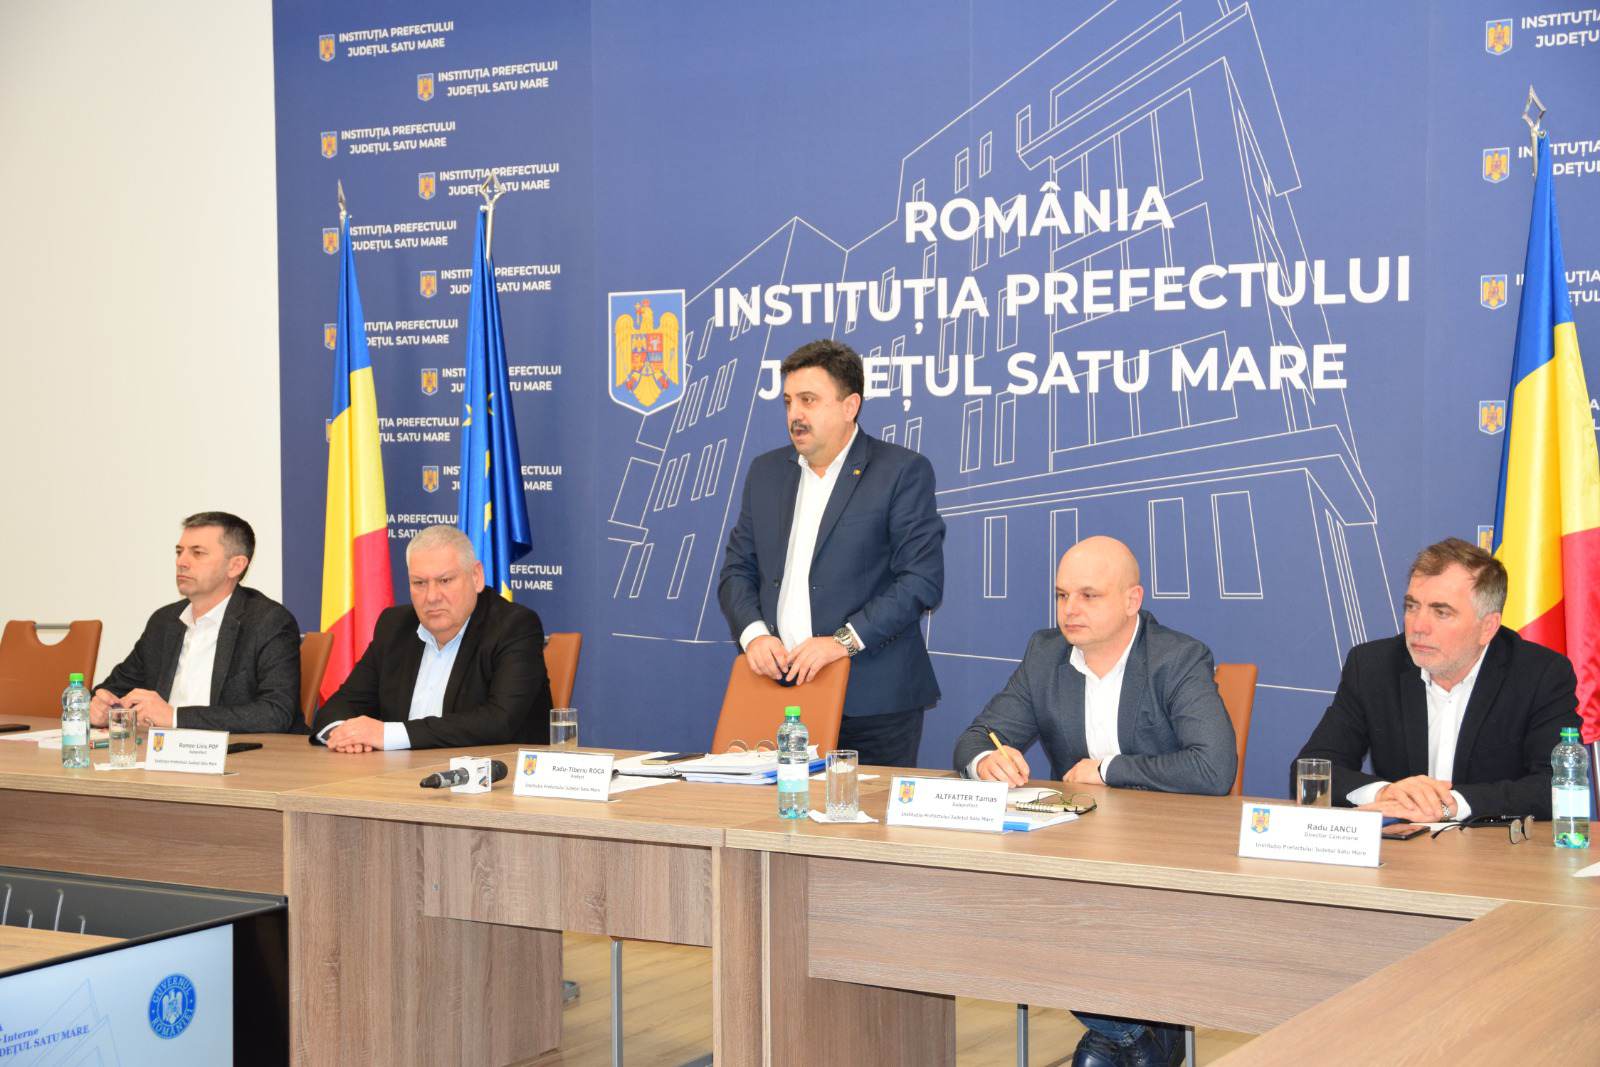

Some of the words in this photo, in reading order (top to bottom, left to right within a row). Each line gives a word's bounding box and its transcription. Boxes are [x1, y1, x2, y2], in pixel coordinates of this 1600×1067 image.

[1522, 9, 1600, 29] INSTITUȚI
[339, 29, 389, 42] INSTITUȚIA
[390, 21, 454, 37] PREFECTULUI
[1535, 30, 1600, 48] JUDEȚU
[348, 44, 389, 56] JUDEȚUL
[391, 41, 415, 52] SATU
[418, 38, 445, 49] MARE
[438, 68, 490, 82] INSTITUȚIA
[492, 61, 558, 76] PREFECTULUI
[448, 84, 490, 96] JUDEȚUL
[492, 80, 517, 92] SATU
[520, 78, 549, 89] MARE
[341, 127, 390, 140] INSTITUȚIA
[392, 121, 456, 135] PREFECTULUI
[350, 142, 391, 154] JUDEȚUL
[393, 140, 417, 150] SATU
[420, 137, 447, 148] MARE
[492, 163, 559, 176] PREFECTULUI
[521, 179, 550, 190] MARE
[904, 181, 1175, 243] ROMÂNIA
[394, 220, 456, 233] PREFECTULUI
[395, 238, 418, 248] SATU
[421, 236, 448, 246] MARE
[441, 269, 472, 279] INSTIT
[494, 264, 560, 276] PREFECTULUI
[523, 280, 551, 290] MARE
[714, 276, 988, 333] INSTITUȚIA
[1007, 255, 1410, 316] PREFECTULUI
[364, 321, 393, 333] ITUȚIA
[396, 319, 458, 330] PREFECTULUI
[396, 336, 419, 345] SATU
[422, 334, 449, 344] MARE
[508, 365, 561, 376] EFECTULUI
[758, 354, 992, 411] JEȚUL
[1006, 349, 1150, 394] SATU
[1172, 344, 1347, 392] MARE
[523, 381, 552, 391] MARE
[396, 417, 459, 427] PREFECTULUI
[397, 432, 420, 442] SATU
[423, 432, 450, 441] MARE
[521, 465, 562, 475] ECTULUI
[524, 481, 552, 490] MARE
[510, 564, 562, 575] EFECTULUI
[525, 580, 553, 590] MARE
[936, 793, 973, 801] ALTFATTER
[1330, 825, 1357, 833] IANCU
[34, 1033, 60, 1048] SATU
[62, 1024, 89, 1040] MARE
